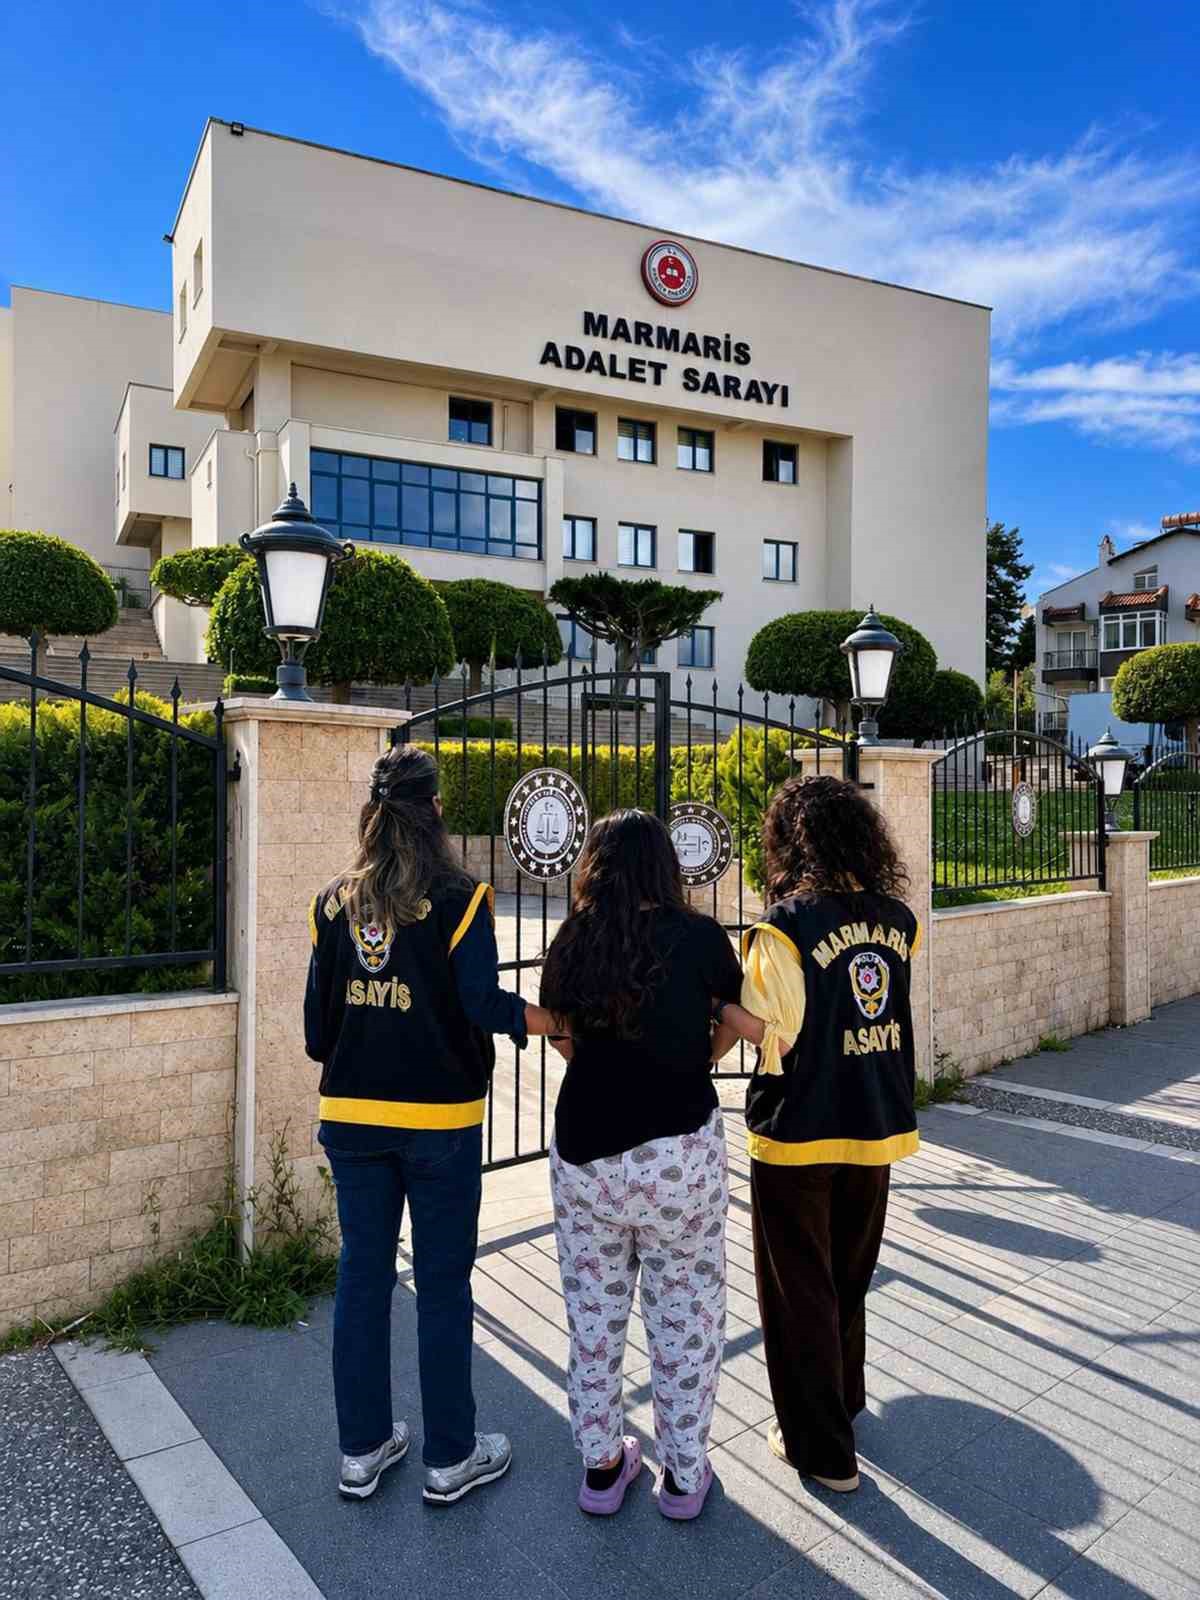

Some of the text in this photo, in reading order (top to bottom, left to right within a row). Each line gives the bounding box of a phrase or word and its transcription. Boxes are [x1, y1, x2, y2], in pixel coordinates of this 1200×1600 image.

[583, 311, 751, 366] MARMARİS
[540, 341, 789, 407] ADALET SARAYI
